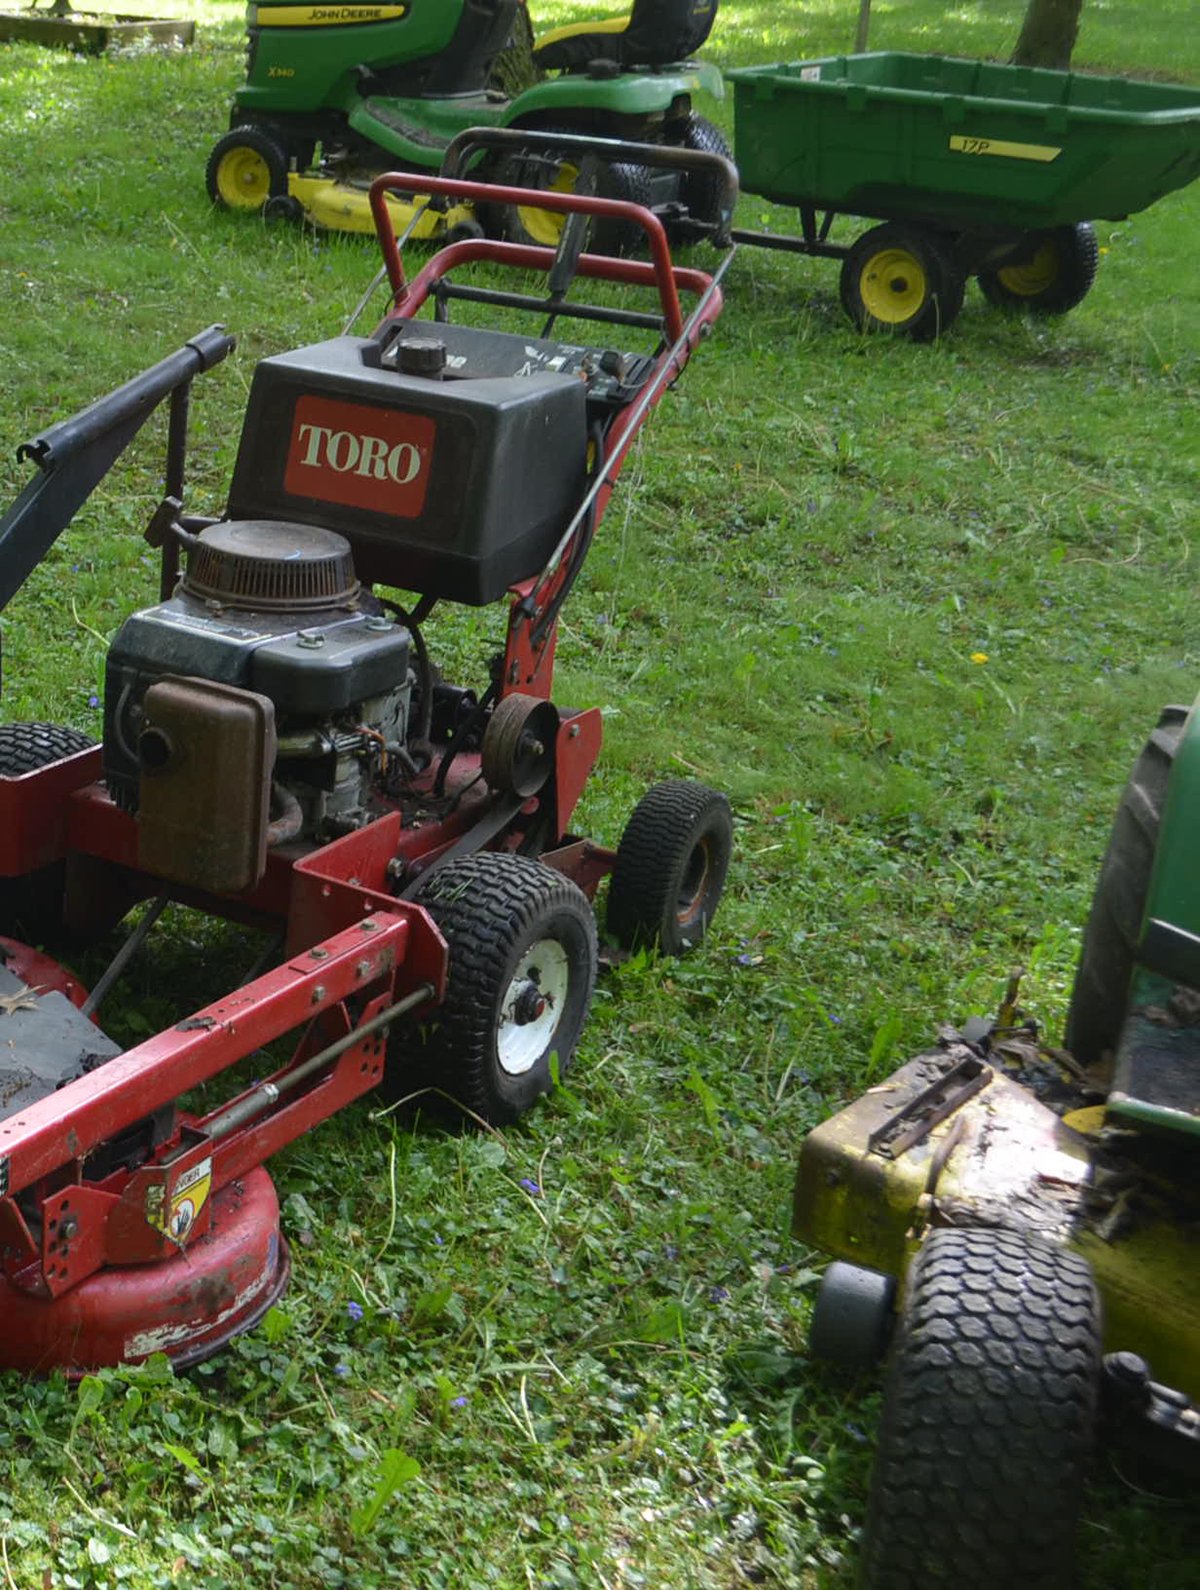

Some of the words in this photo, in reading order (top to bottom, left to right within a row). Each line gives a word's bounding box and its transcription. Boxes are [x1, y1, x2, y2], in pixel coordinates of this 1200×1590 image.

[308, 8, 340, 20] JOHN
[341, 8, 382, 19] DEERE
[961, 139, 991, 154] 17P
[298, 423, 421, 484] TORO
